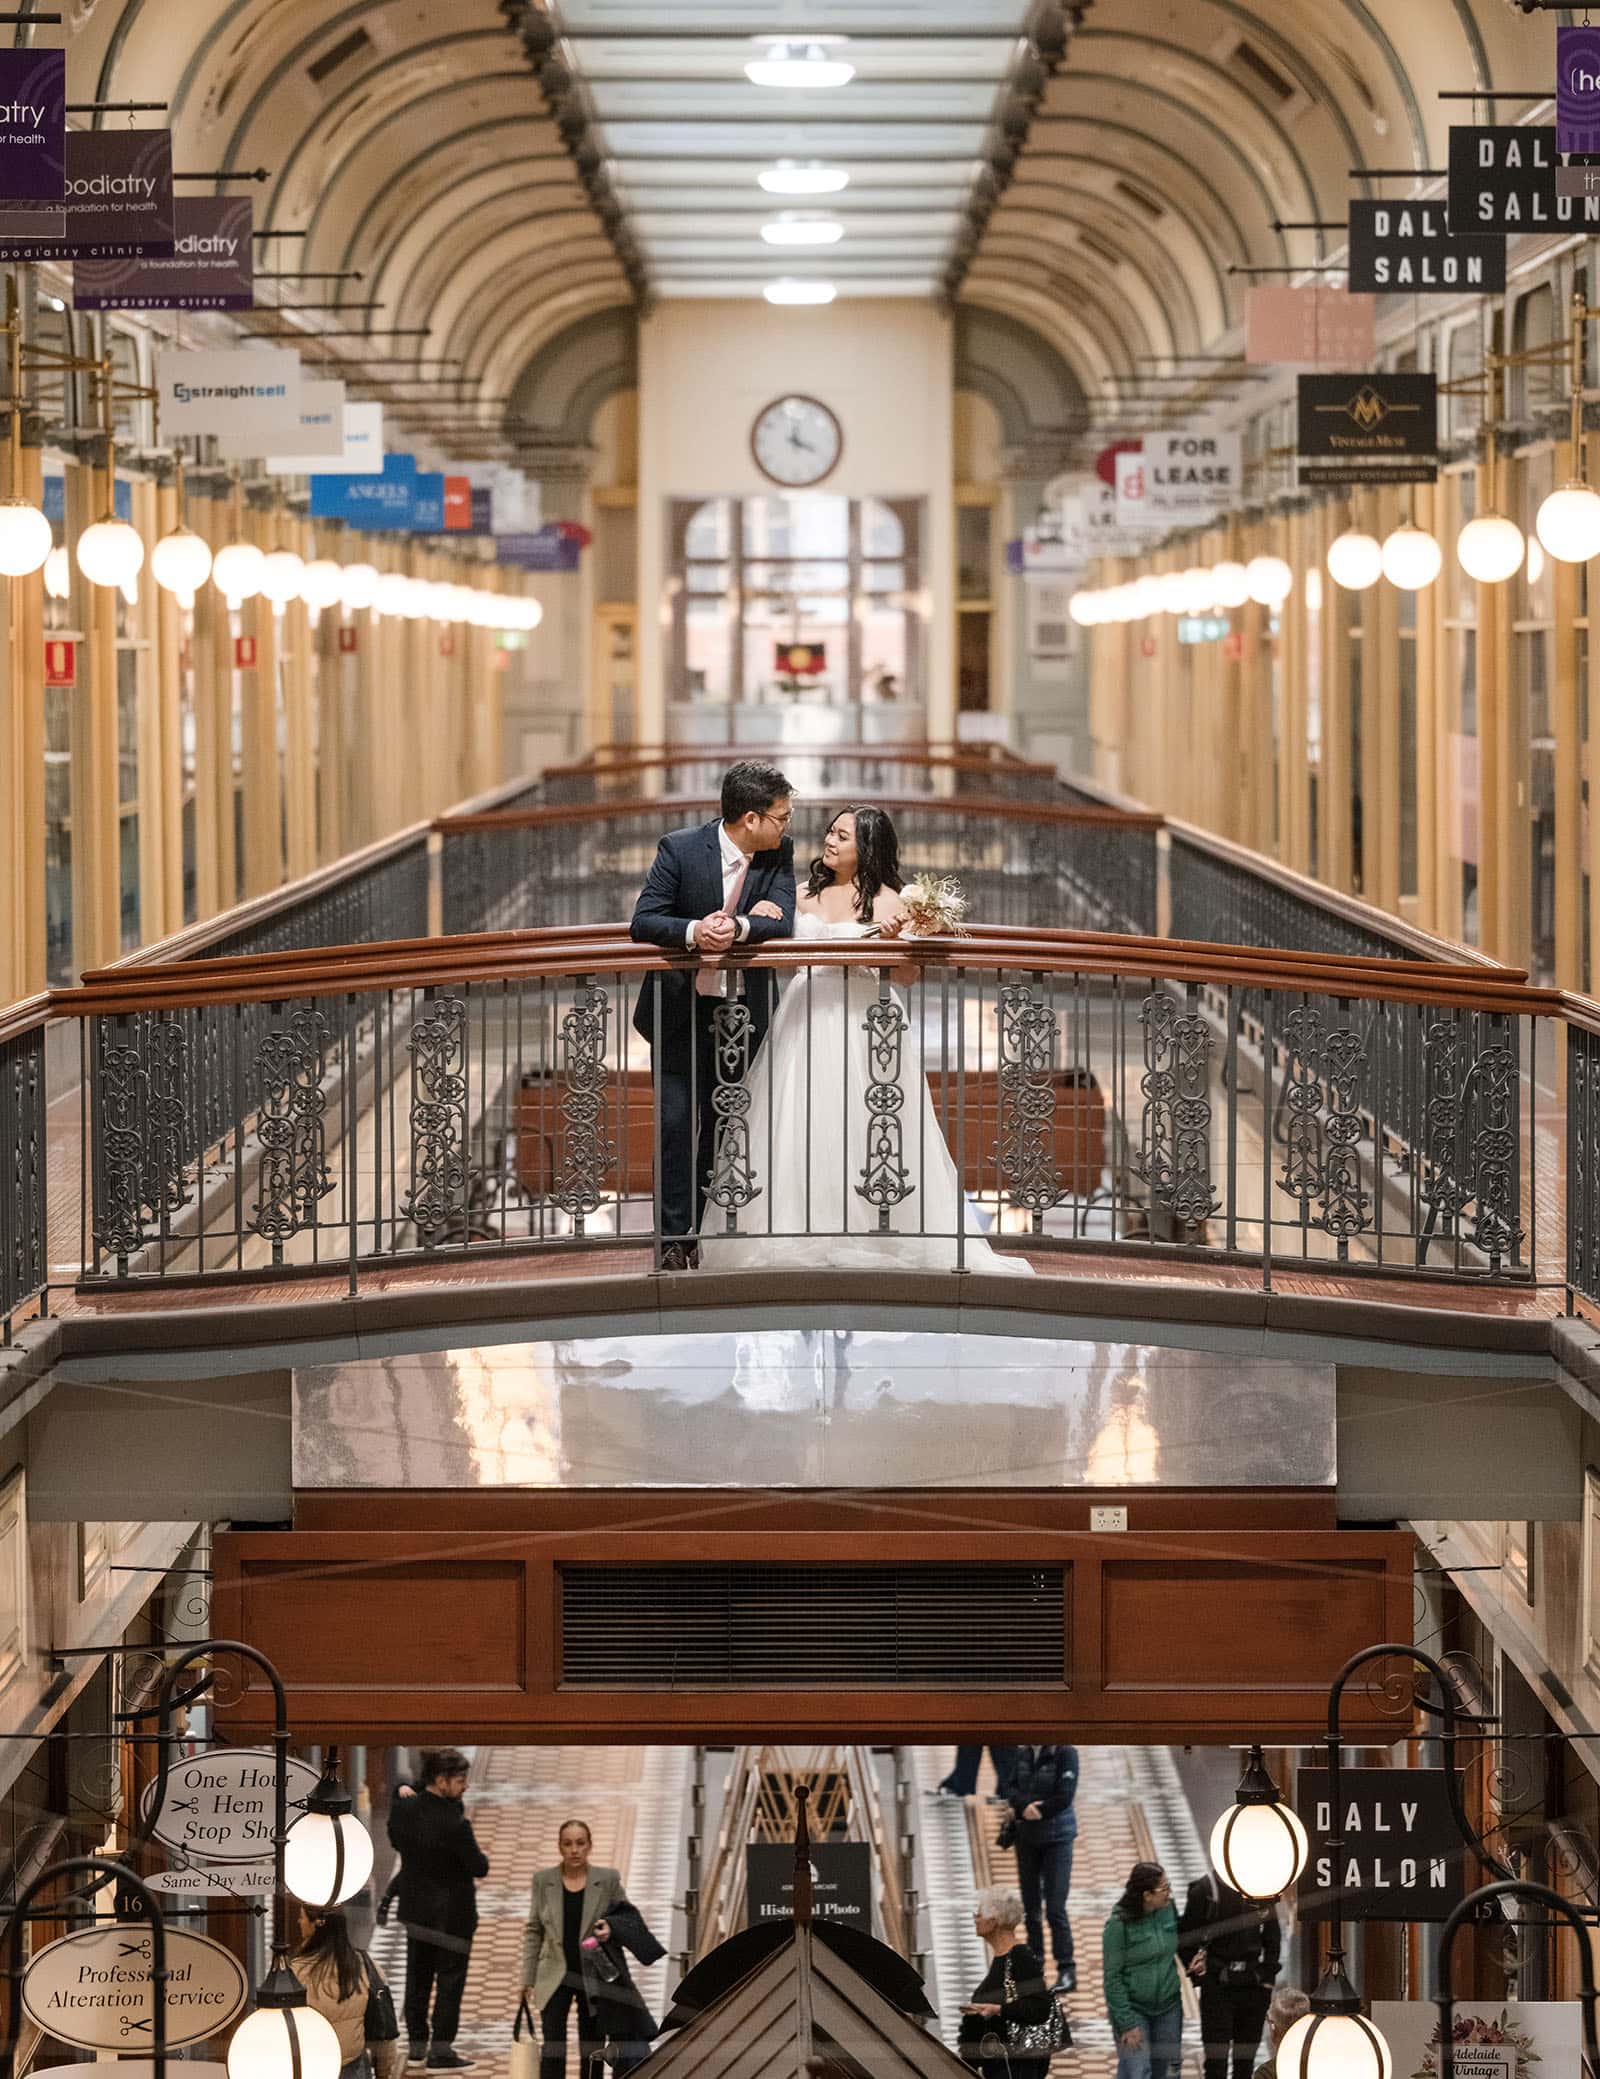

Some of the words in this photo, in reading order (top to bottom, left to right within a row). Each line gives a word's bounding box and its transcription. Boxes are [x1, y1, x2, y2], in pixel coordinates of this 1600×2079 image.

[9, 133, 46, 144] health
[111, 203, 123, 211] for
[126, 202, 157, 211] health
[1479, 192, 1600, 221] SALON
[1375, 211, 1450, 236] DAL
[1, 246, 79, 259] podiatry
[90, 246, 144, 256] clinic
[175, 235, 239, 256] diatry
[1375, 257, 1483, 283] SALON
[179, 297, 227, 307] clinic
[192, 384, 286, 399] straightsell
[1167, 439, 1218, 457] FOR
[1153, 466, 1231, 484] LEASE
[184, 1769, 228, 1789] One
[213, 1794, 264, 1814] Hem
[1316, 1802, 1418, 1831] DALY
[183, 1820, 232, 1844] Stop
[242, 1820, 276, 1839] Sho
[161, 1875, 201, 1888] Same
[207, 1872, 235, 1890] Day
[241, 1872, 276, 1887] Alter
[1316, 1858, 1447, 1888] SALON
[123, 1895, 143, 1913] 16
[760, 1903, 820, 1916] Histol
[824, 1903, 860, 1915] Photo
[1474, 1902, 1493, 1919] 15
[78, 1963, 192, 1984] Professial
[47, 1989, 144, 2008] Alteration
[163, 1986, 225, 2006] ervice
[1453, 2048, 1501, 2060] Adelaide
